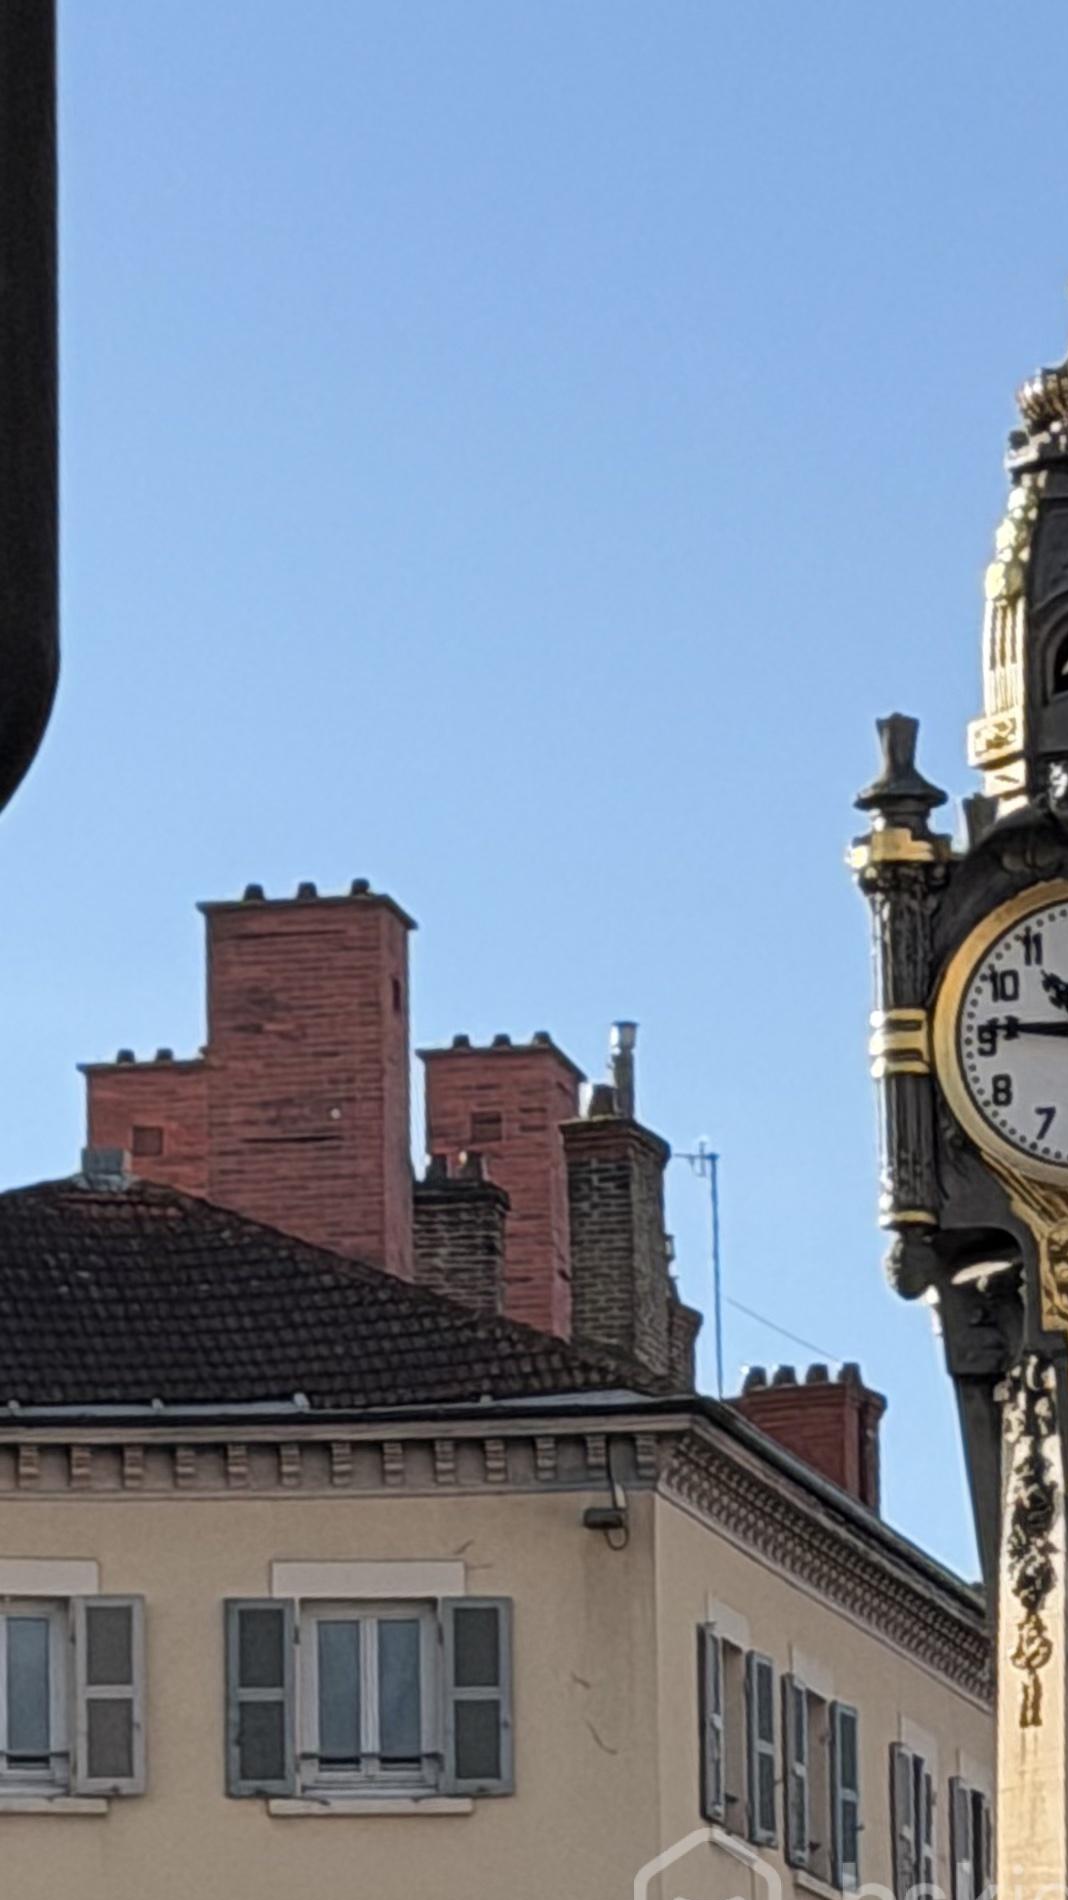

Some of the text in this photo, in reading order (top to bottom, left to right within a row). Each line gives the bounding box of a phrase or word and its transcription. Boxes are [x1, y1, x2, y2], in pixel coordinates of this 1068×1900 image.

[1023, 930, 1043, 966] 11
[990, 969, 1019, 1002] 10
[977, 1022, 998, 1057] 9
[991, 1074, 1013, 1107] 8
[1034, 1106, 1057, 1141] 7
